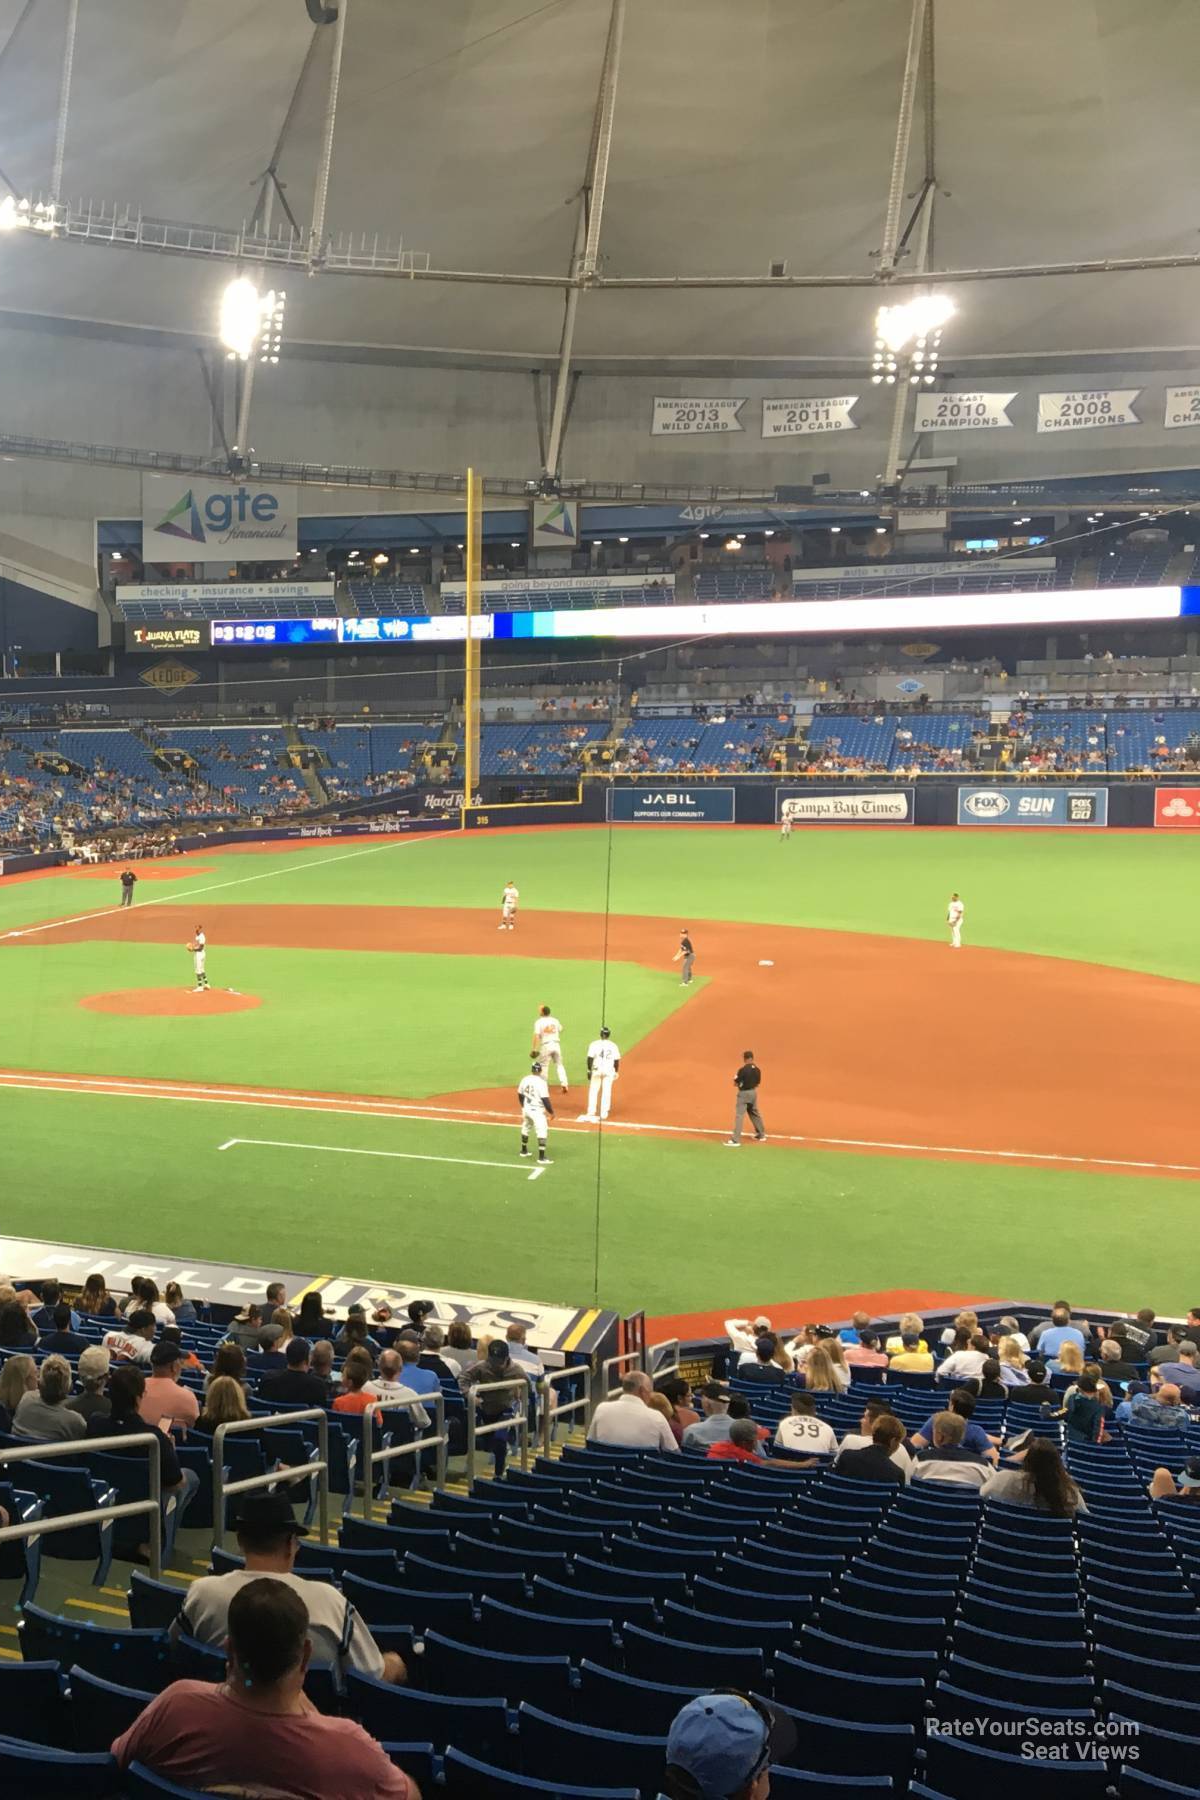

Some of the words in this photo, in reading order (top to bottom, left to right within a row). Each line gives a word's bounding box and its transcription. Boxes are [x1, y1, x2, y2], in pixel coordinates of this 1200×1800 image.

[657, 401, 701, 409] AMERICAN
[766, 402, 811, 411] AMERICAN
[815, 399, 850, 408] LEAGUE
[937, 403, 987, 417] 2010
[1060, 401, 1112, 417] 2008
[675, 408, 719, 422] 2013
[786, 408, 831, 423] 2011
[1044, 414, 1126, 428] CHAMPIONS
[696, 422, 729, 430] CARD
[772, 424, 802, 432] WILD
[808, 421, 842, 430] CARD
[921, 417, 999, 428] CHAMPIONS
[205, 487, 279, 532] gte
[219, 524, 288, 544] financial
[140, 585, 188, 598] checking
[201, 583, 254, 595] insurance
[268, 583, 310, 597] savings
[501, 580, 530, 590] going
[533, 579, 573, 588] beyond
[575, 579, 611, 587] money
[152, 669, 187, 683] LEDGE
[424, 793, 454, 808] Hard
[642, 794, 696, 804] JABIL
[974, 797, 999, 807] FOX
[1018, 797, 1055, 812] SUN
[1071, 798, 1092, 807] FOX
[787, 801, 830, 816] Tampa
[832, 801, 859, 816] Bay
[862, 800, 902, 814] Times
[476, 815, 489, 825] 315
[1071, 811, 1091, 820] GO
[598, 1049, 613, 1060] 42
[34, 1254, 272, 1295] FIELD
[793, 1423, 820, 1438] 39
